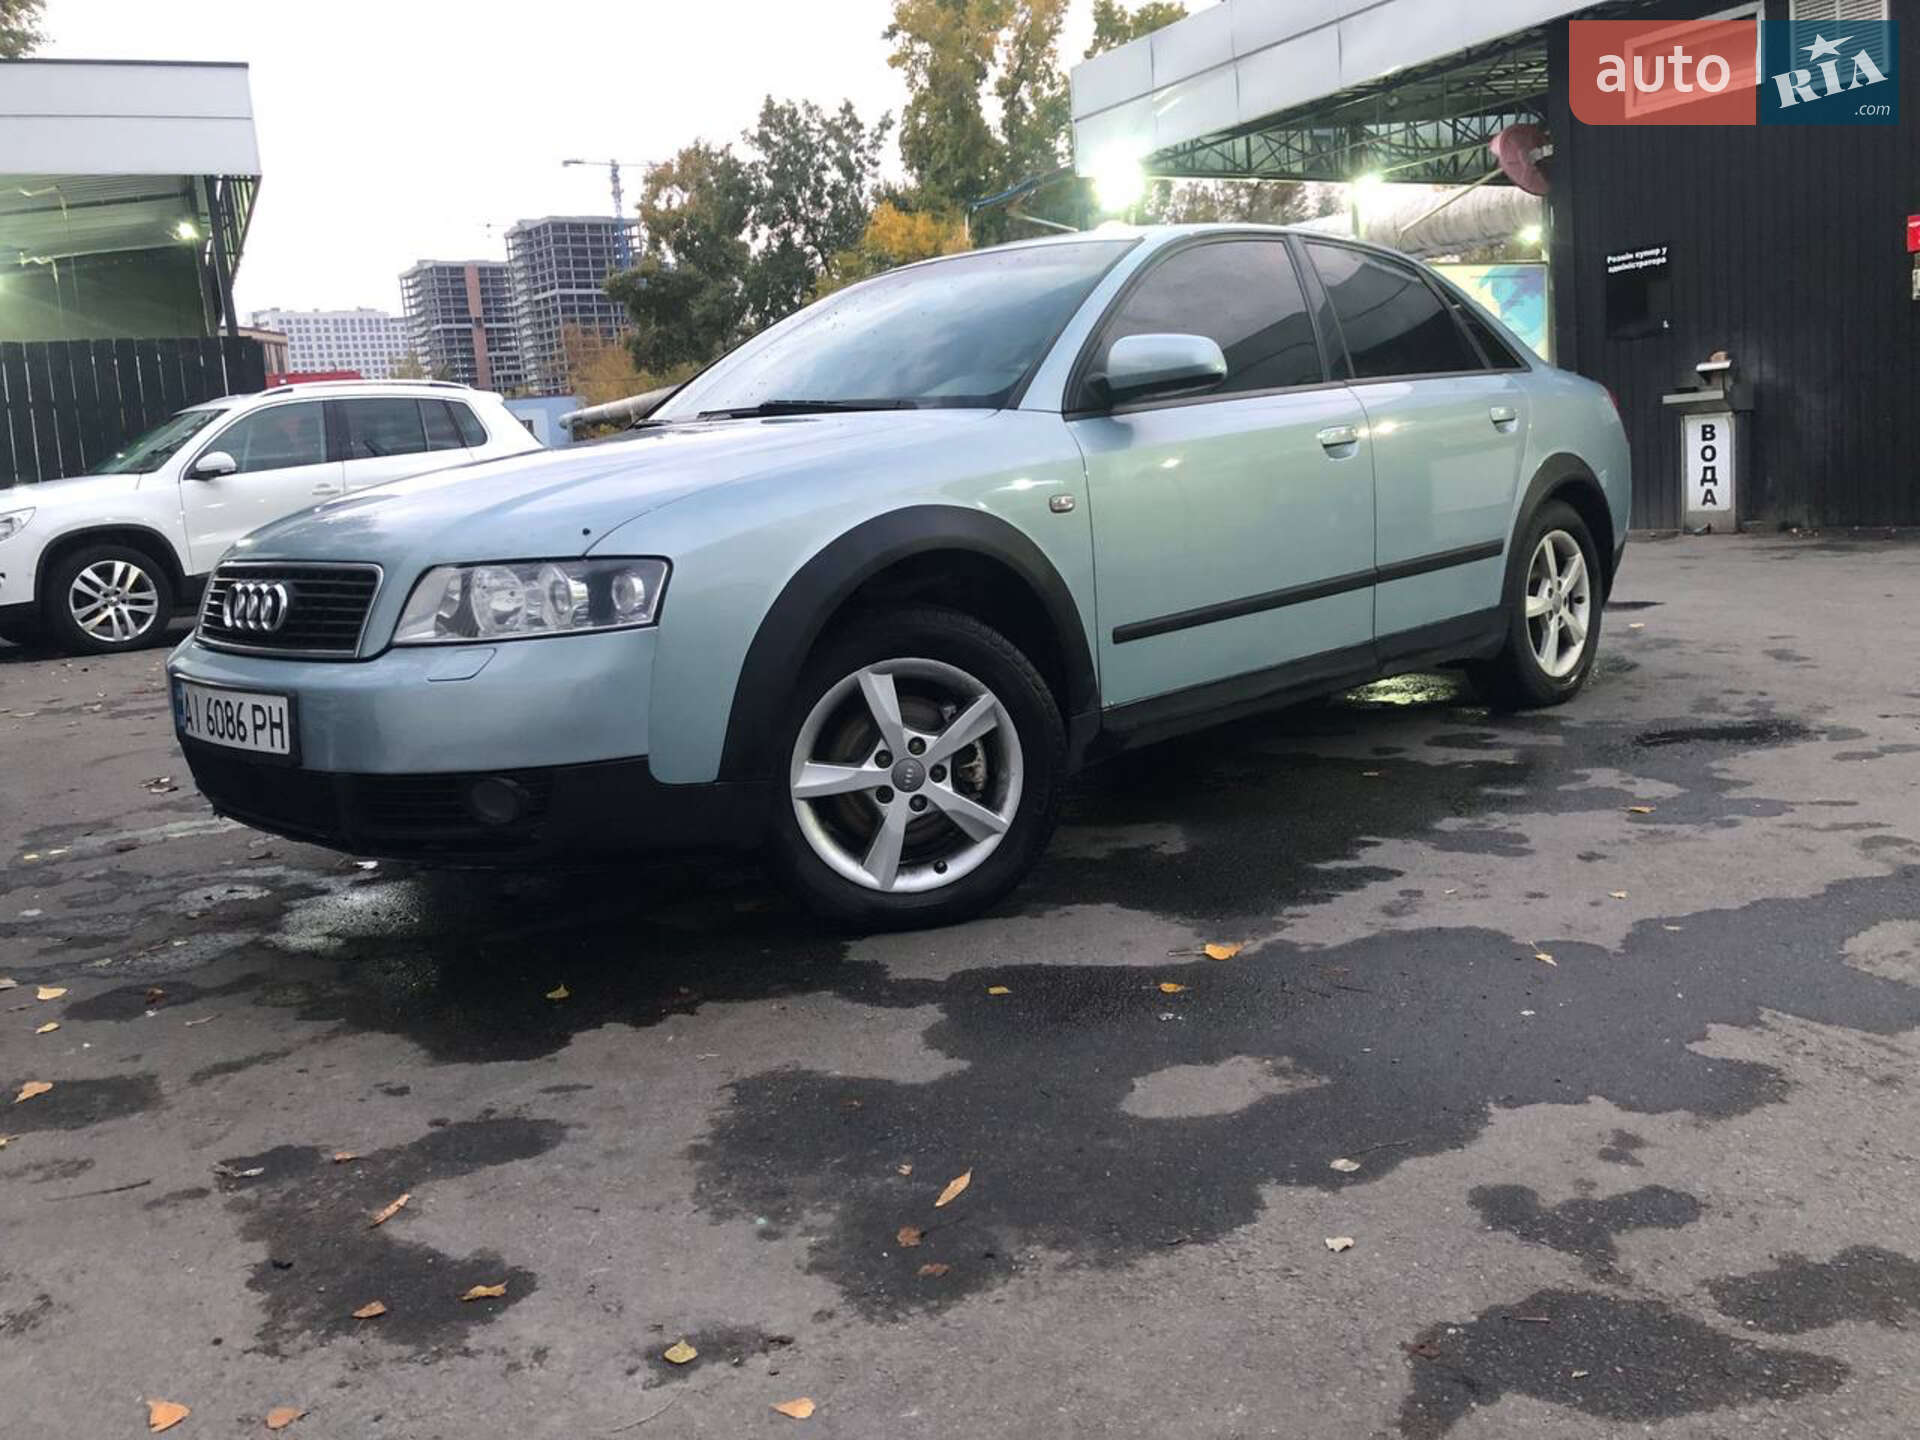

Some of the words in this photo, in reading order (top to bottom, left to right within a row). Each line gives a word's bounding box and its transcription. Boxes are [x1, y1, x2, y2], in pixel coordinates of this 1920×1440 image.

[1700, 424, 1717, 506] ВОДА
[206, 697, 247, 742] 6086
[252, 704, 285, 749] PH
